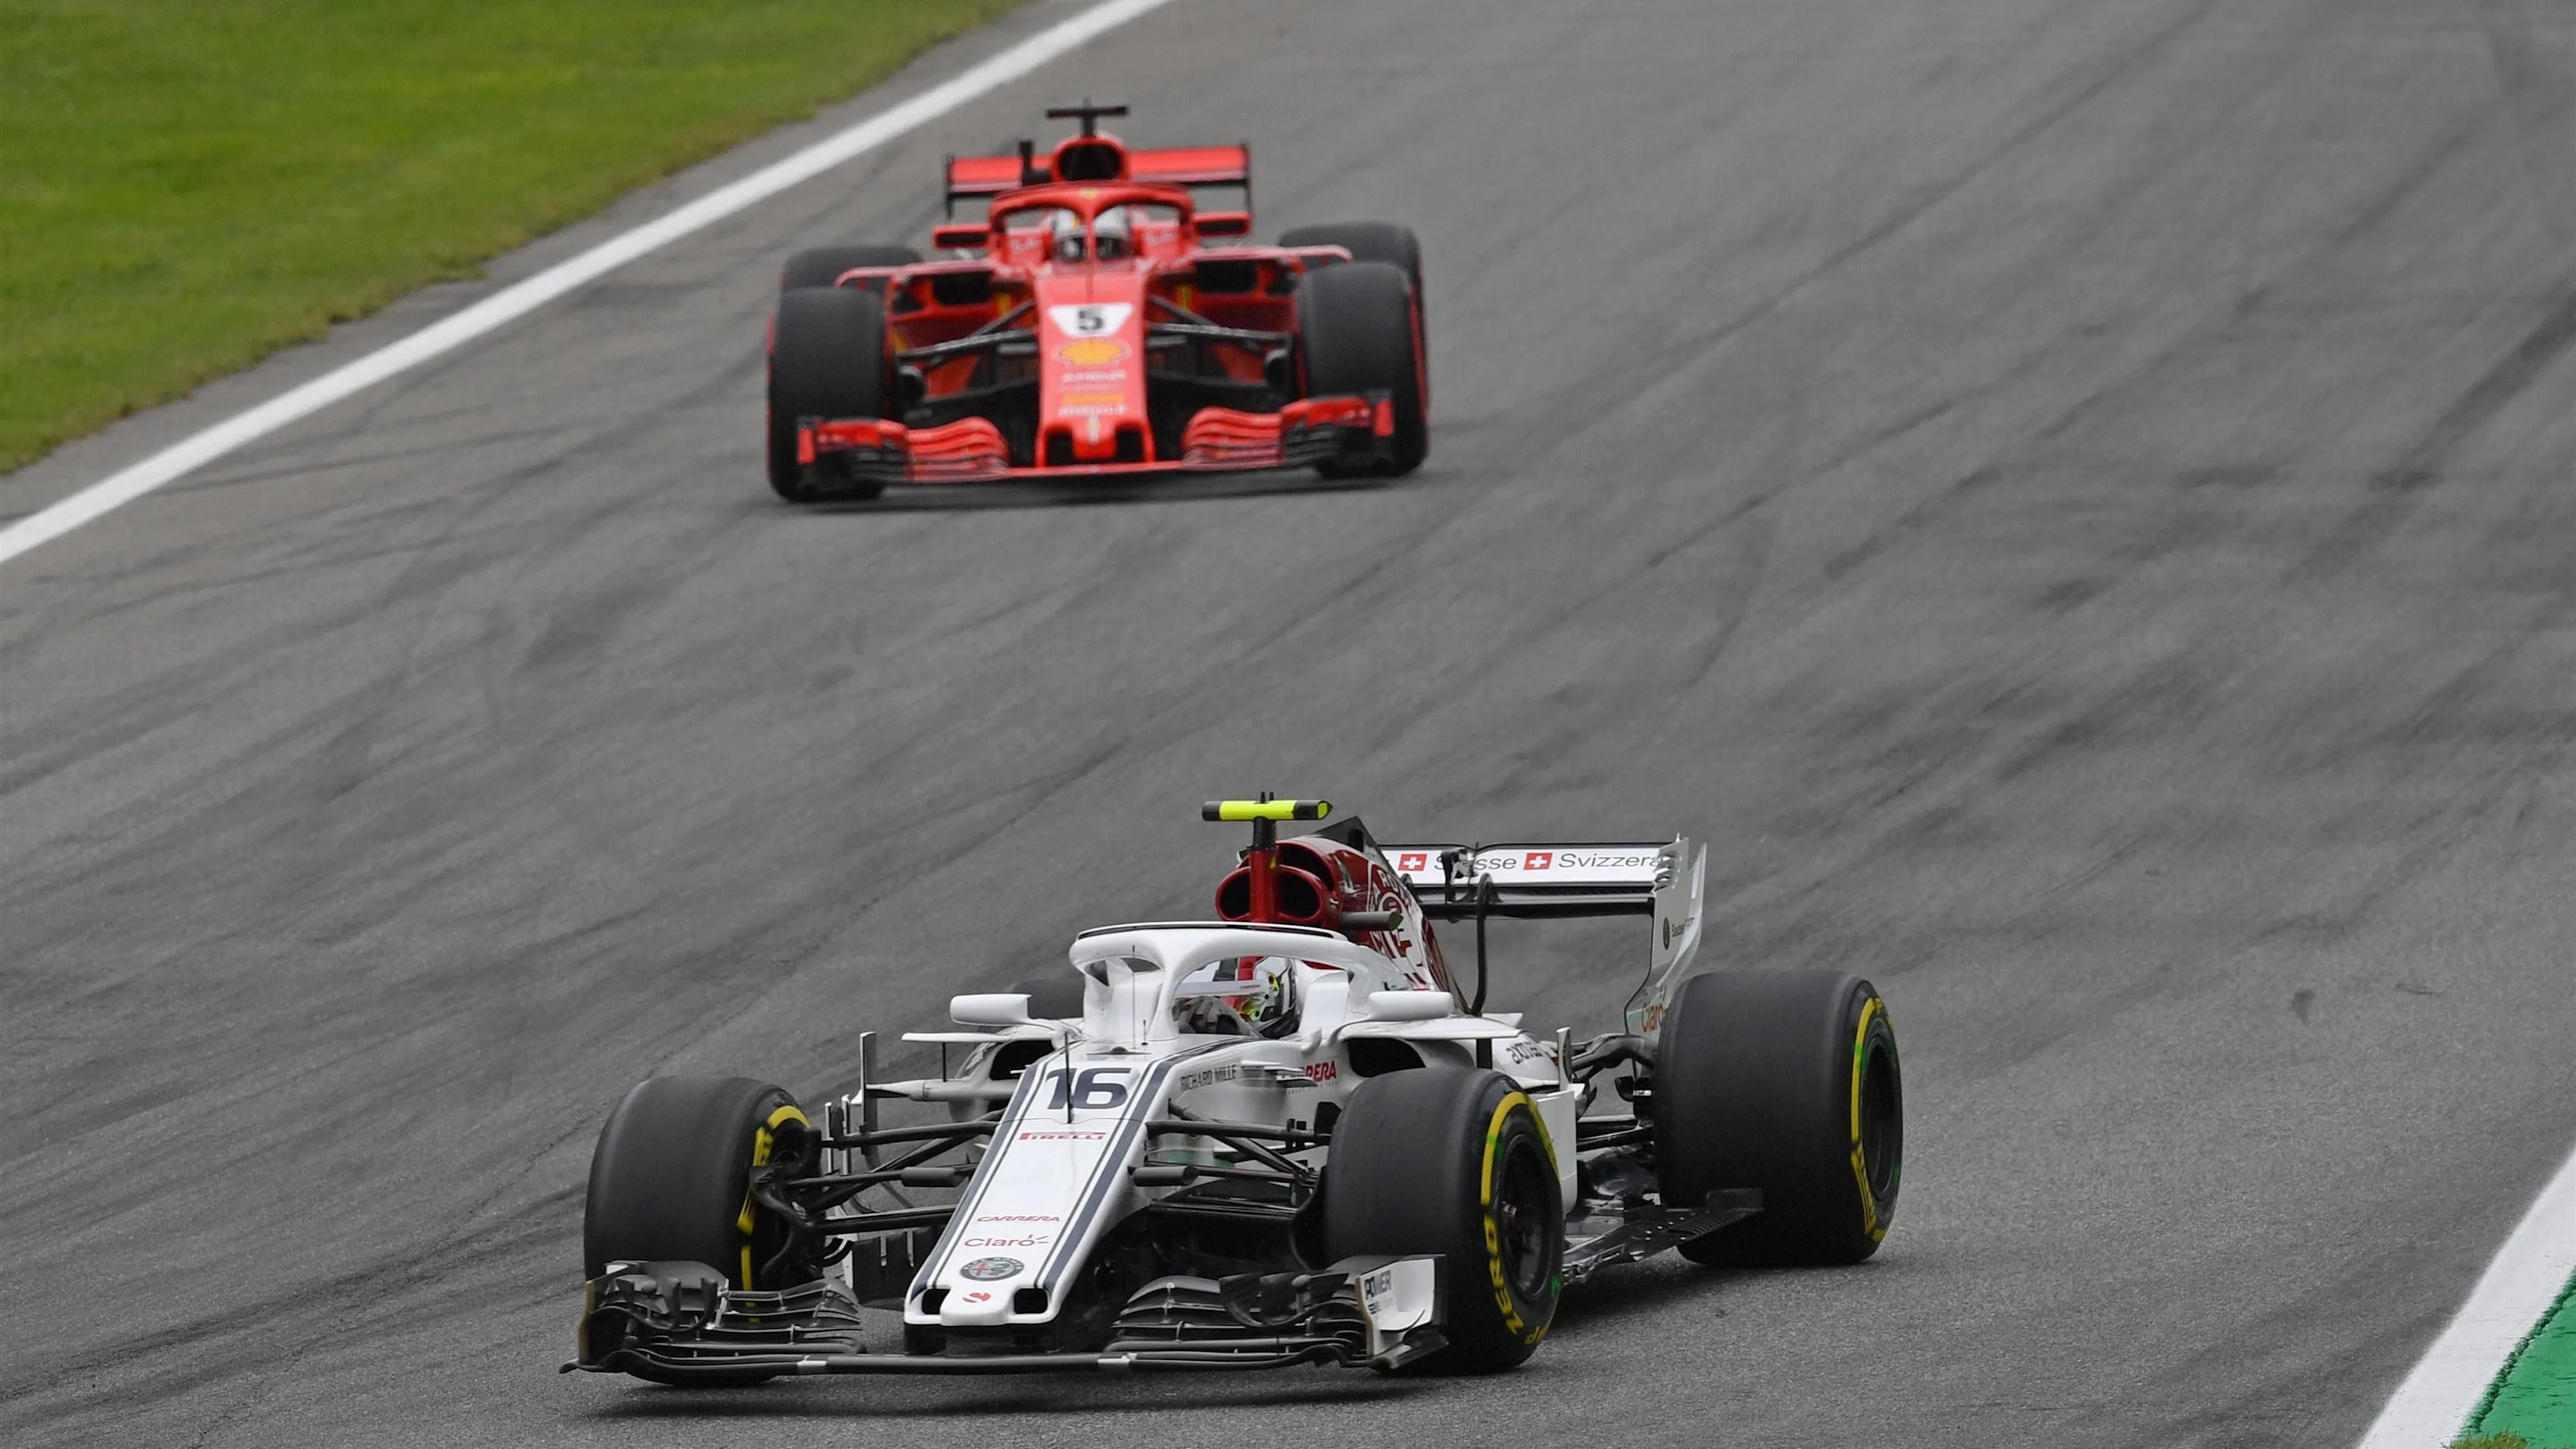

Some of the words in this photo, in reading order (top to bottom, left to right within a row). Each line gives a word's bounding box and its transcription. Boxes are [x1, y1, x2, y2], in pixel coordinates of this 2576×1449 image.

[1077, 310, 1104, 331] 5
[1434, 854, 1517, 870] Ssse
[1045, 1068, 1132, 1110] 16
